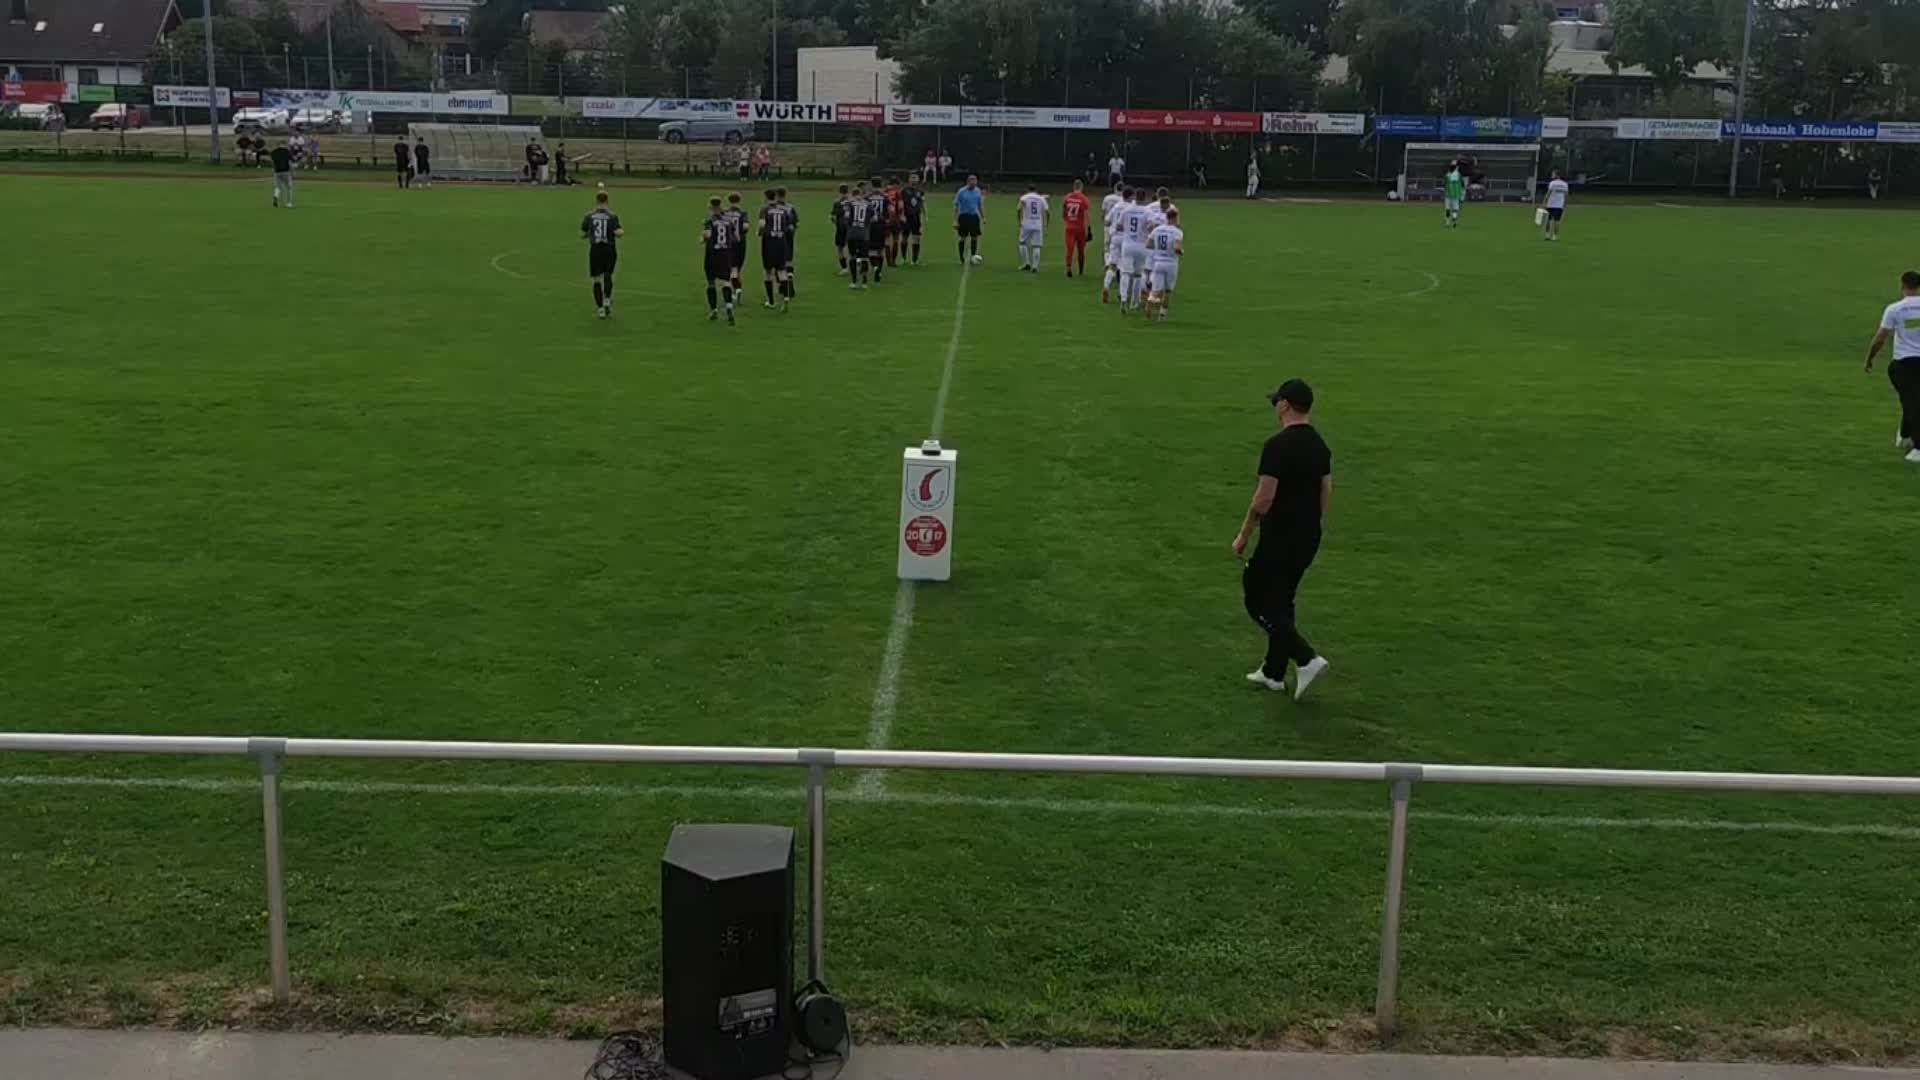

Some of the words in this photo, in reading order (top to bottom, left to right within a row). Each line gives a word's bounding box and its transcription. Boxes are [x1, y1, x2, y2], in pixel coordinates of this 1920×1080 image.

[754, 102, 832, 121] WÜRTH
[1801, 124, 1876, 137] Hohenlohe
[853, 204, 867, 222] 10
[592, 219, 608, 238] 31
[773, 214, 782, 231] 11
[1130, 216, 1138, 232] 9
[717, 225, 727, 244] 8
